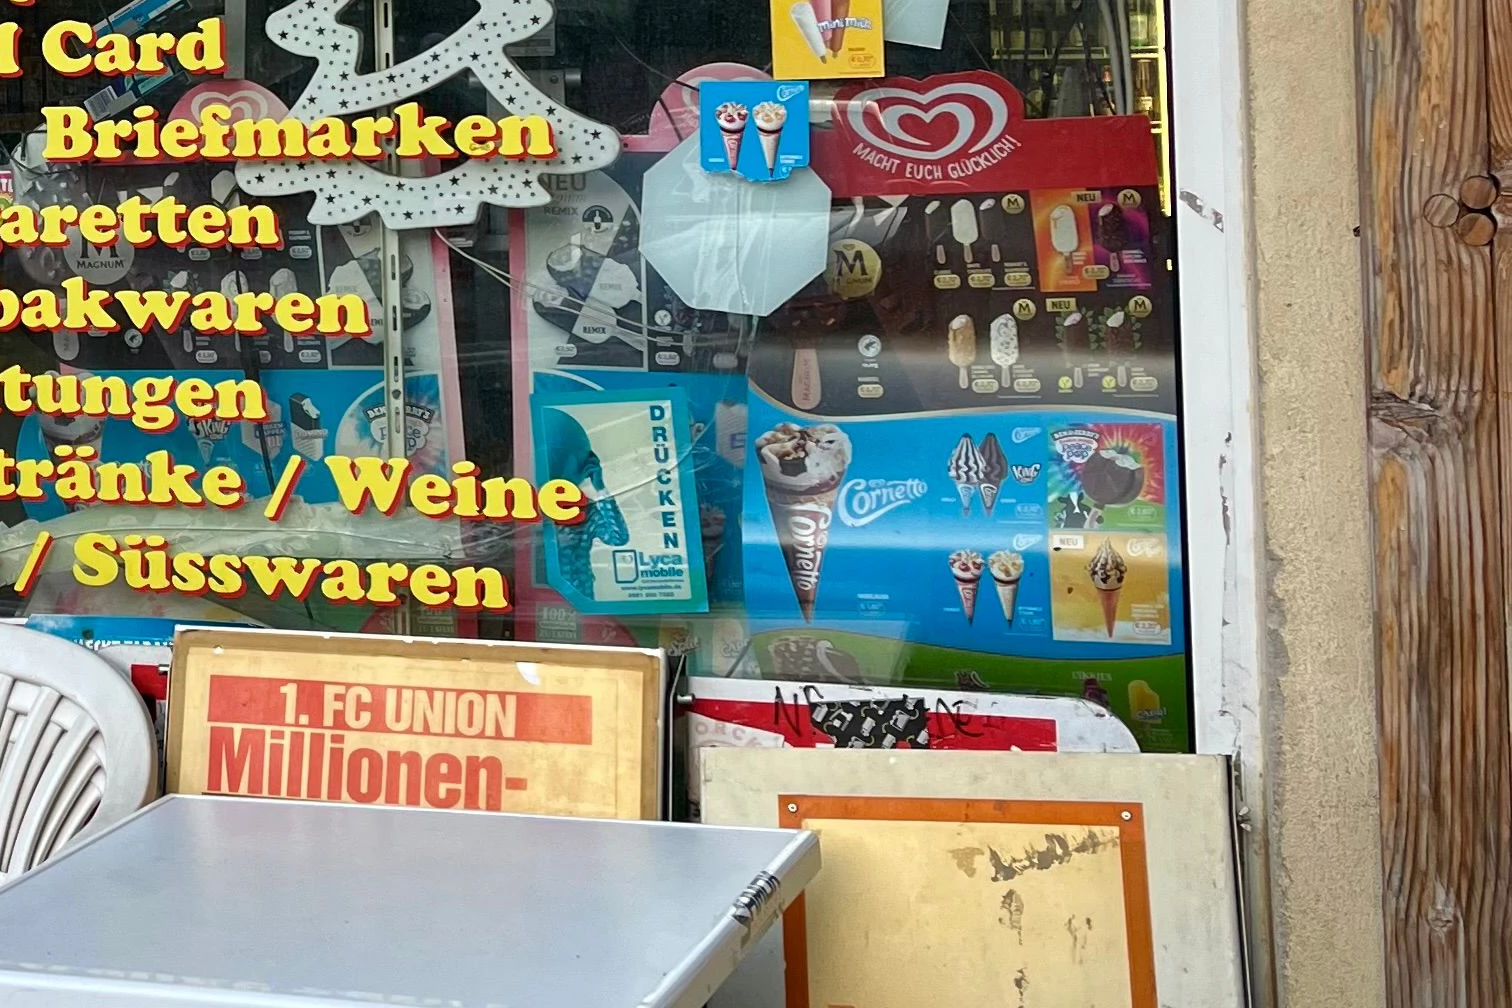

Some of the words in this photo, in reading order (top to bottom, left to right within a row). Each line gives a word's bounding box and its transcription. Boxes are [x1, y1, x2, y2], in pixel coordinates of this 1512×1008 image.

[41, 17, 226, 78] Card
[41, 103, 558, 162] Briefmarken
[852, 142, 900, 174] MACHT
[905, 162, 943, 180] EUCH
[947, 134, 1022, 180] GLÜCKLICH!
[1077, 193, 1096, 202] NEU
[76, 259, 125, 269] MAGNUM
[1051, 301, 1070, 310] NEU
[324, 455, 586, 526] Weine
[649, 405, 679, 549] DRÜCKEN
[838, 478, 928, 527] Cornetto
[73, 532, 511, 612] Süsswaren
[639, 552, 682, 572] Lyca
[790, 501, 832, 591] Cornetto
[640, 568, 684, 578] mobile
[280, 683, 306, 727] 1.
[322, 690, 374, 729] FC
[384, 692, 517, 736] UNION
[206, 727, 530, 811] Millionen-
